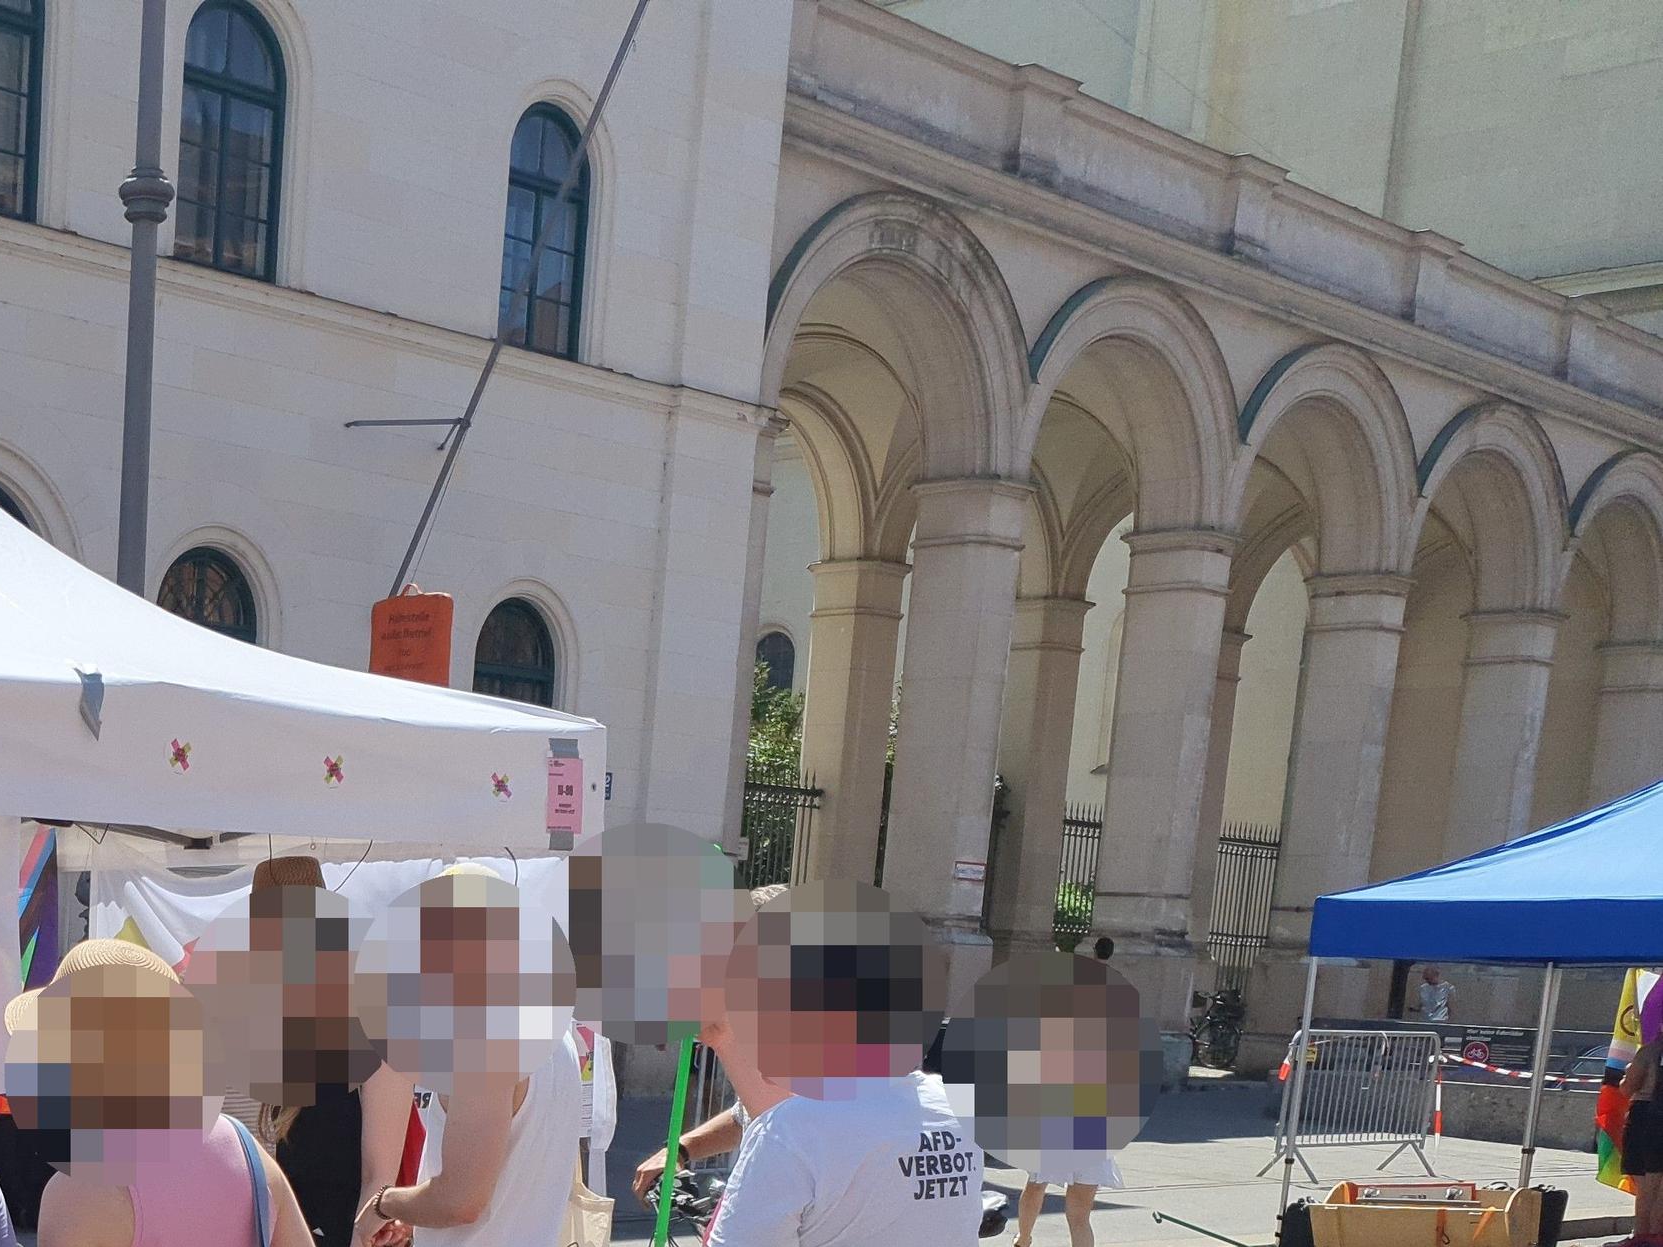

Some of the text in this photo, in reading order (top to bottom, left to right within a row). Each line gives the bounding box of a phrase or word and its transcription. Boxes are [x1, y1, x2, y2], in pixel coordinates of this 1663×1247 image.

[917, 1130, 962, 1153] AFD-
[898, 1151, 976, 1178] VERBOT.
[913, 1175, 968, 1200] JETZT
